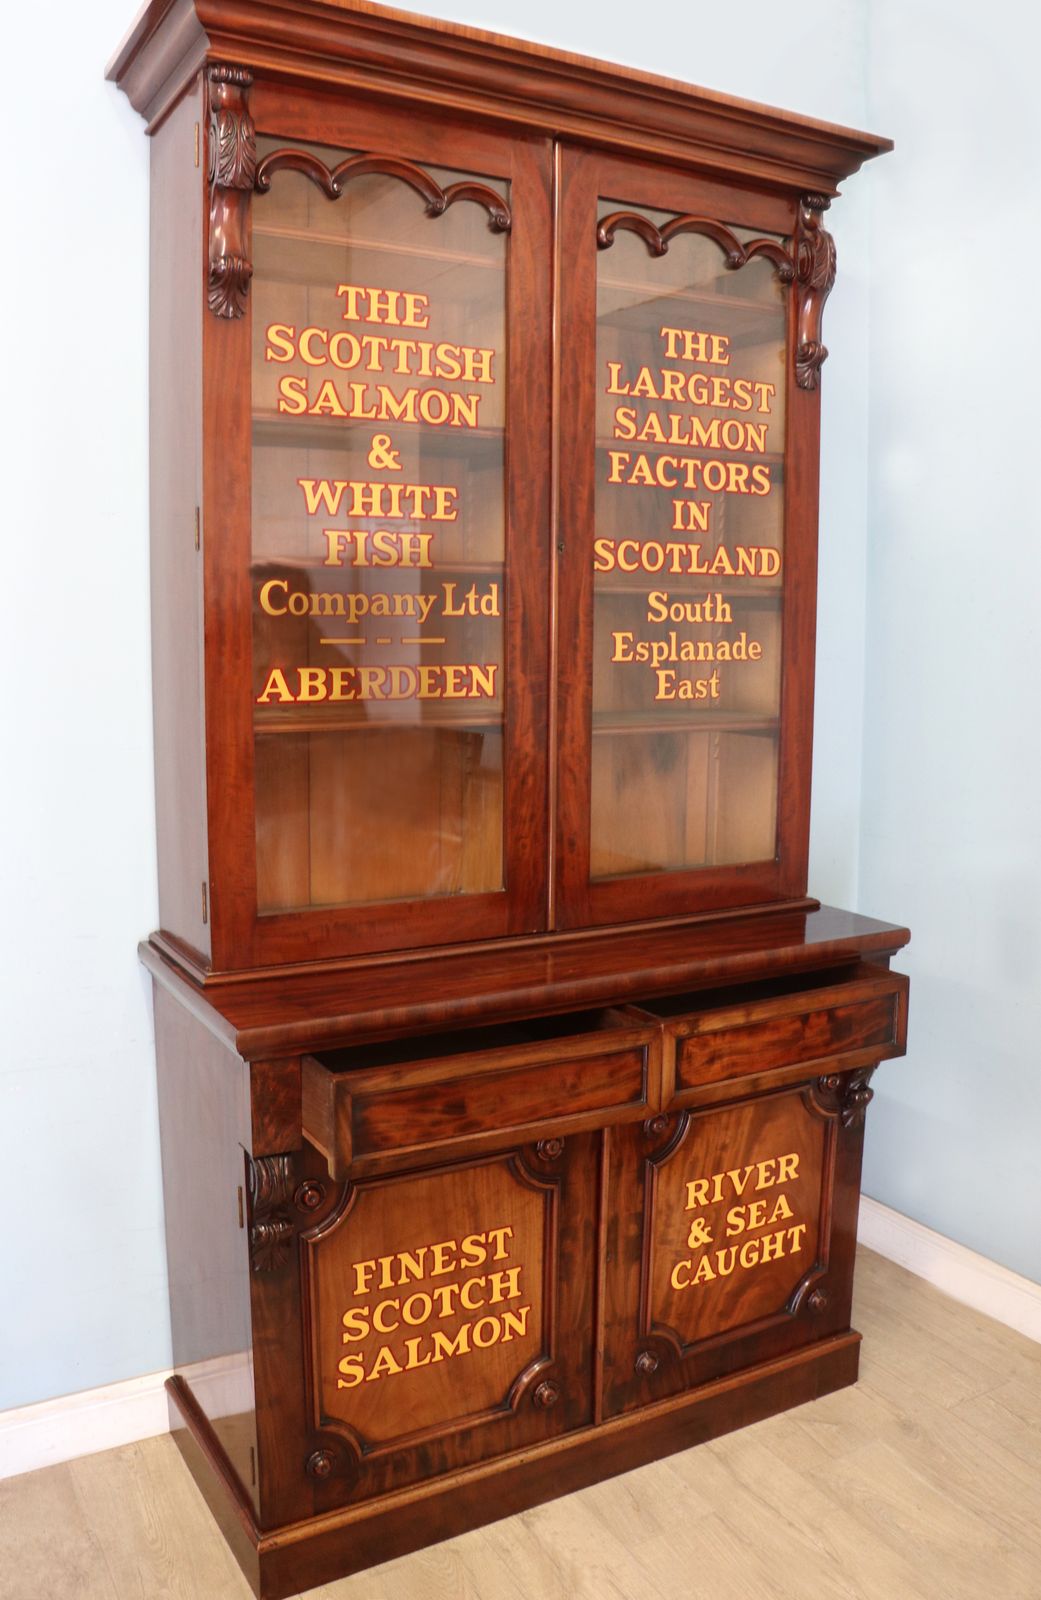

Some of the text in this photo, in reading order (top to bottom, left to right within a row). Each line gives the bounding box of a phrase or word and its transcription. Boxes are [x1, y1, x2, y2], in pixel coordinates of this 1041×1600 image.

[336, 283, 431, 329] THE
[265, 323, 494, 383] SCOTTISH
[660, 327, 730, 365] THE
[279, 376, 480, 428] SALMON
[607, 362, 776, 414] LARGEST
[367, 434, 402, 470] &
[613, 407, 768, 452] SALMON
[607, 452, 771, 496] FACTORS
[298, 479, 460, 521] WHITE
[672, 499, 711, 532] IN
[324, 529, 434, 568] FISH
[593, 539, 781, 577] SCOTLAND
[259, 579, 501, 624] Company Ltd
[646, 591, 733, 623] South
[611, 631, 762, 668] Esplanade
[256, 664, 498, 704] ABERDEEN
[655, 670, 720, 700] East
[685, 1153, 800, 1211] RIVER
[686, 1193, 794, 1249] & SEA
[351, 1226, 513, 1296] FINEST
[670, 1224, 807, 1291] CAUGHT
[342, 1267, 523, 1344] SCOTCH
[337, 1306, 531, 1390] SALMON
